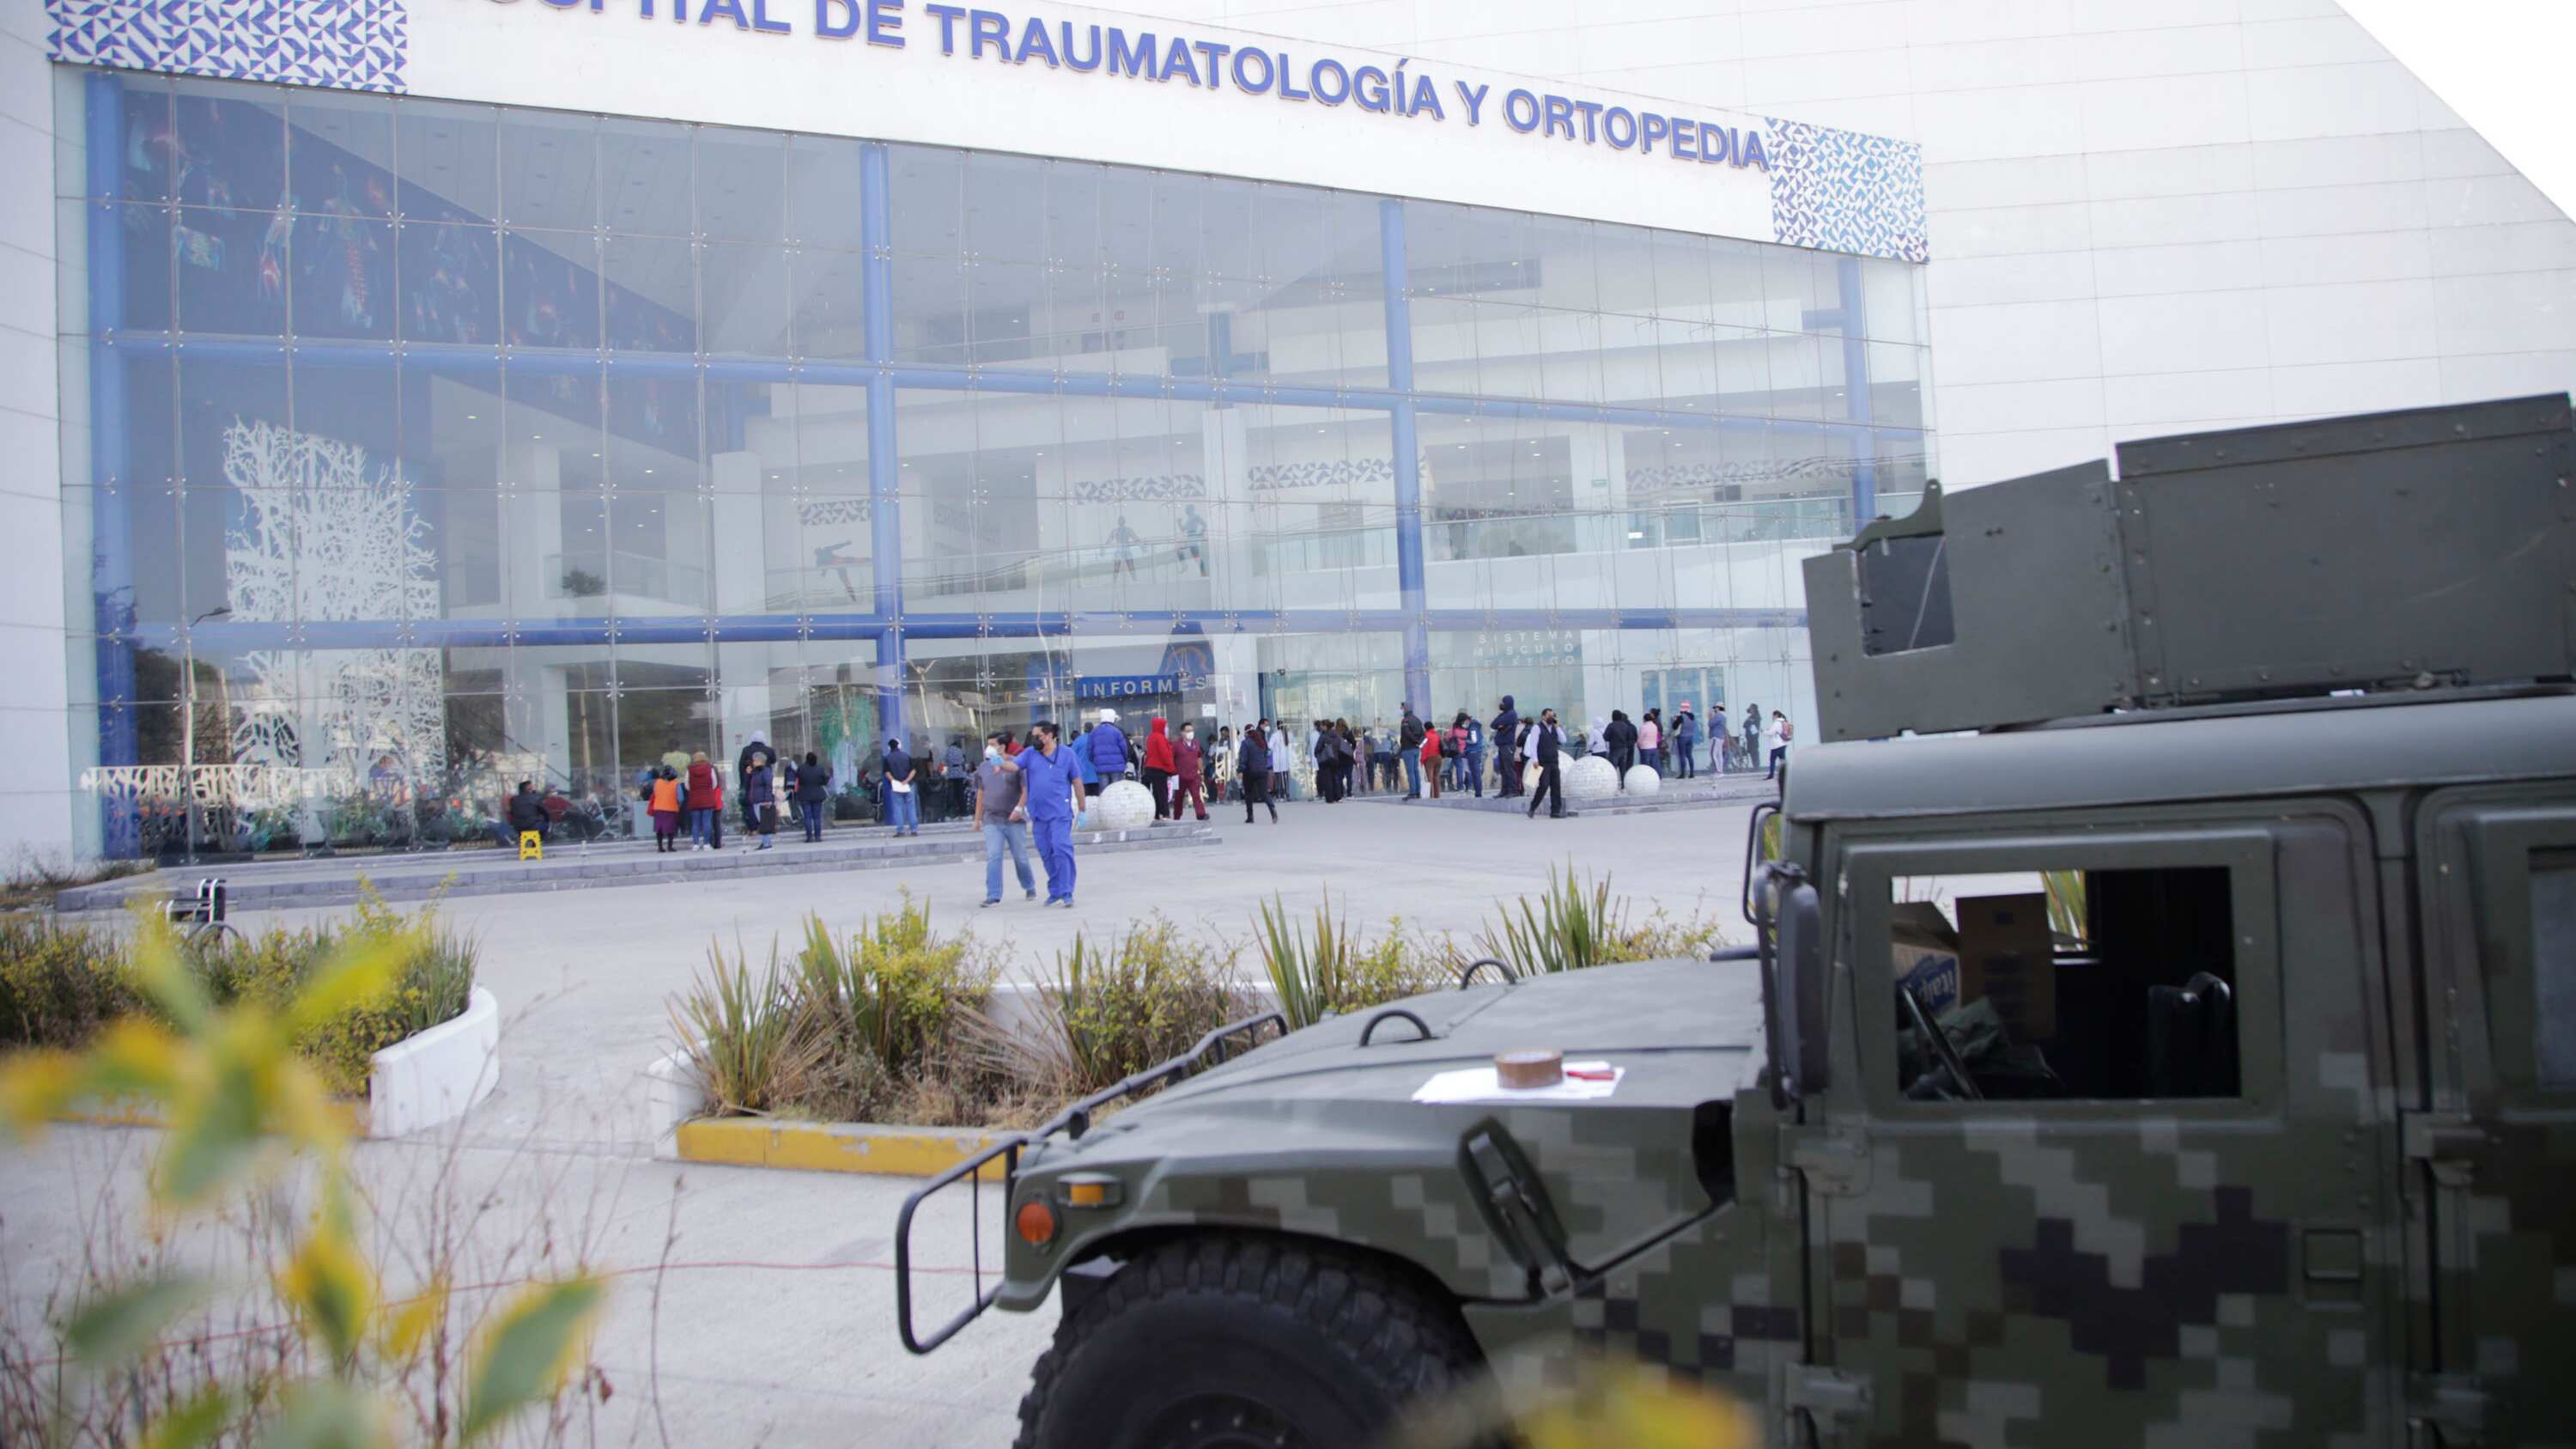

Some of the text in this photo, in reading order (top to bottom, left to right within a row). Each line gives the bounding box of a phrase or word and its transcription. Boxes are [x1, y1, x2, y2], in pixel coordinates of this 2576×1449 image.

[815, 0, 905, 47] DE
[926, 3, 1444, 120] TRAUMATOLOGÍA
[1455, 81, 1488, 125] Y
[1504, 88, 1771, 171] ORTOPEDIA
[1477, 630, 1573, 644] SISTEMA
[1082, 676, 1207, 697] INFORMES
